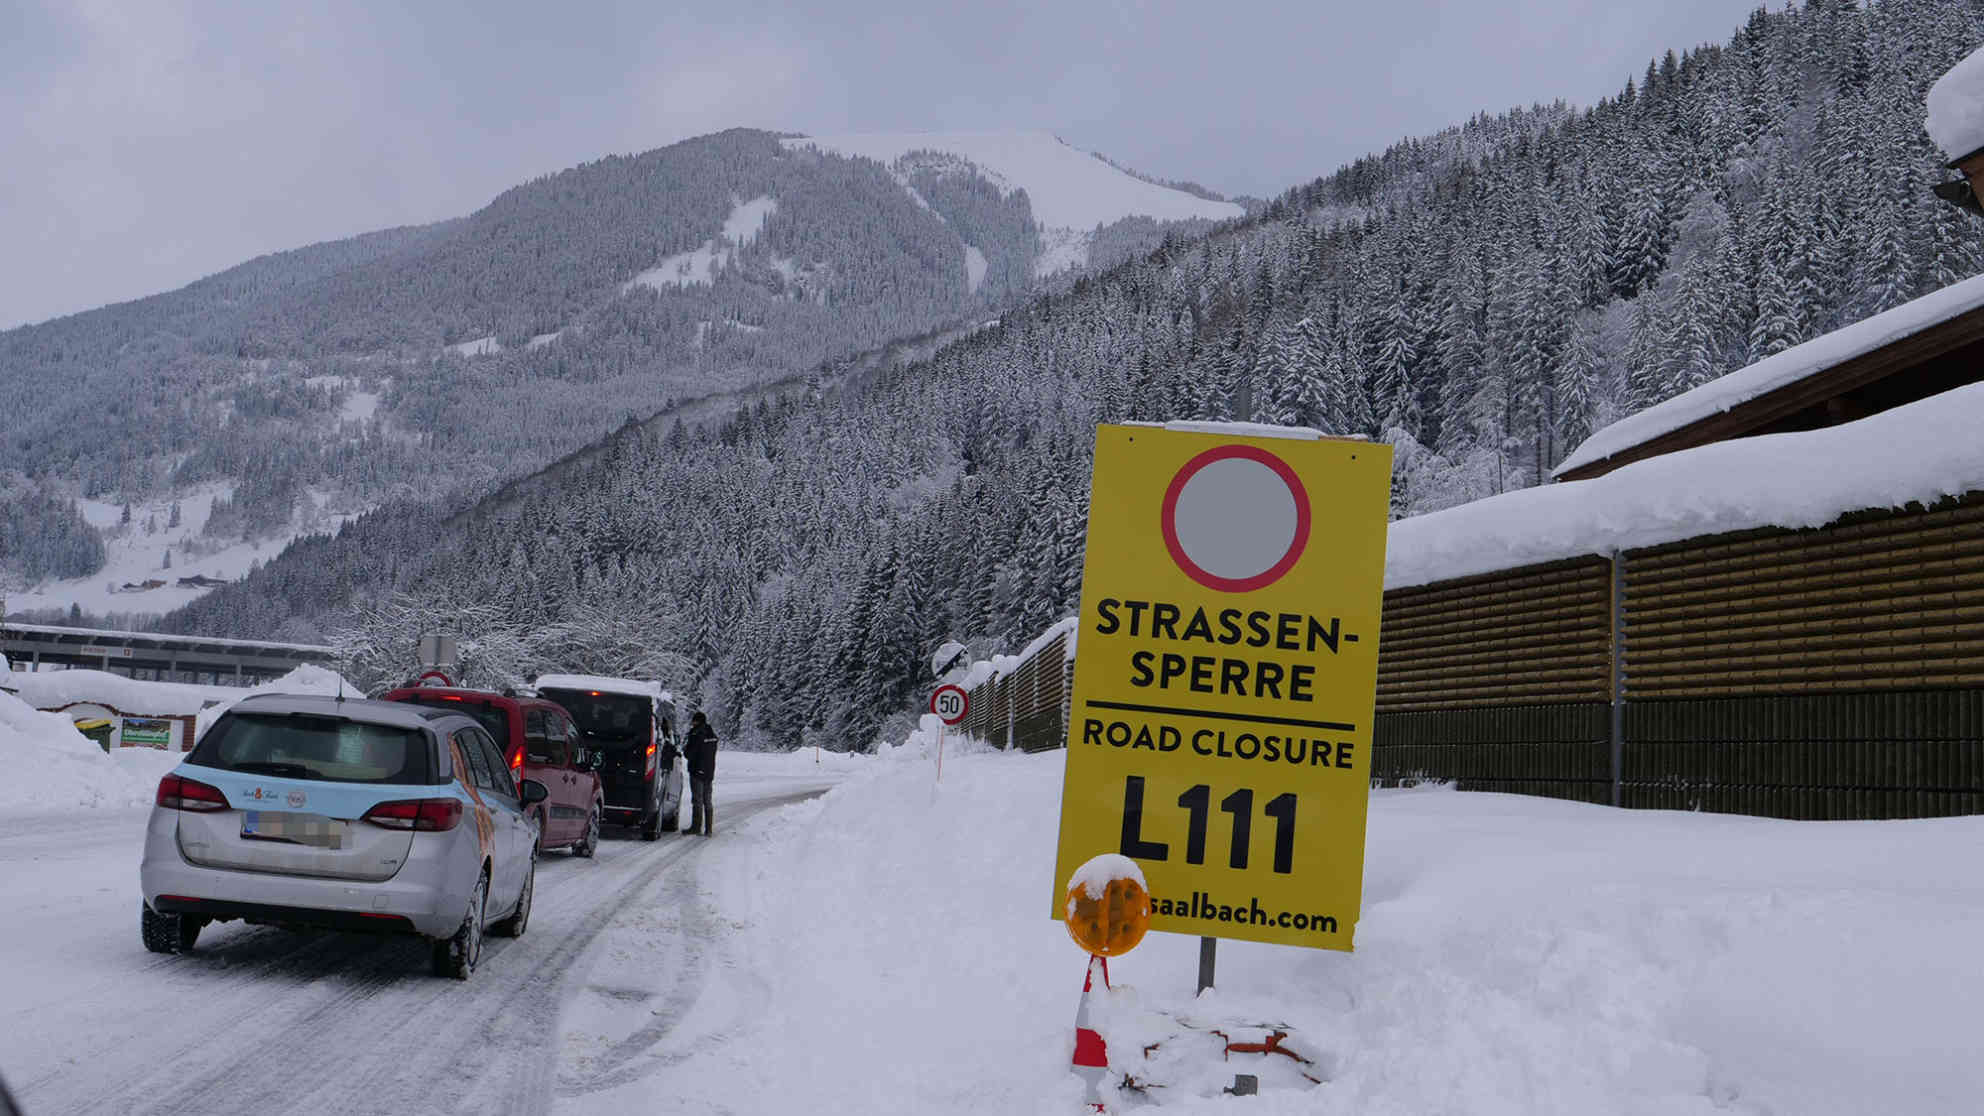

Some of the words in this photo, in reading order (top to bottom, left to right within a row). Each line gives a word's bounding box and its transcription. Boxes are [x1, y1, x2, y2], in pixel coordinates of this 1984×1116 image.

[1096, 598, 1360, 655] STRASSEN-
[1130, 650, 1316, 703] SPERRE
[940, 695, 960, 714] 50
[1082, 718, 1182, 756] ROAD
[1191, 729, 1356, 770] CLOSURE
[1119, 774, 1298, 875] L111
[1150, 891, 1338, 934] saalbach.com
